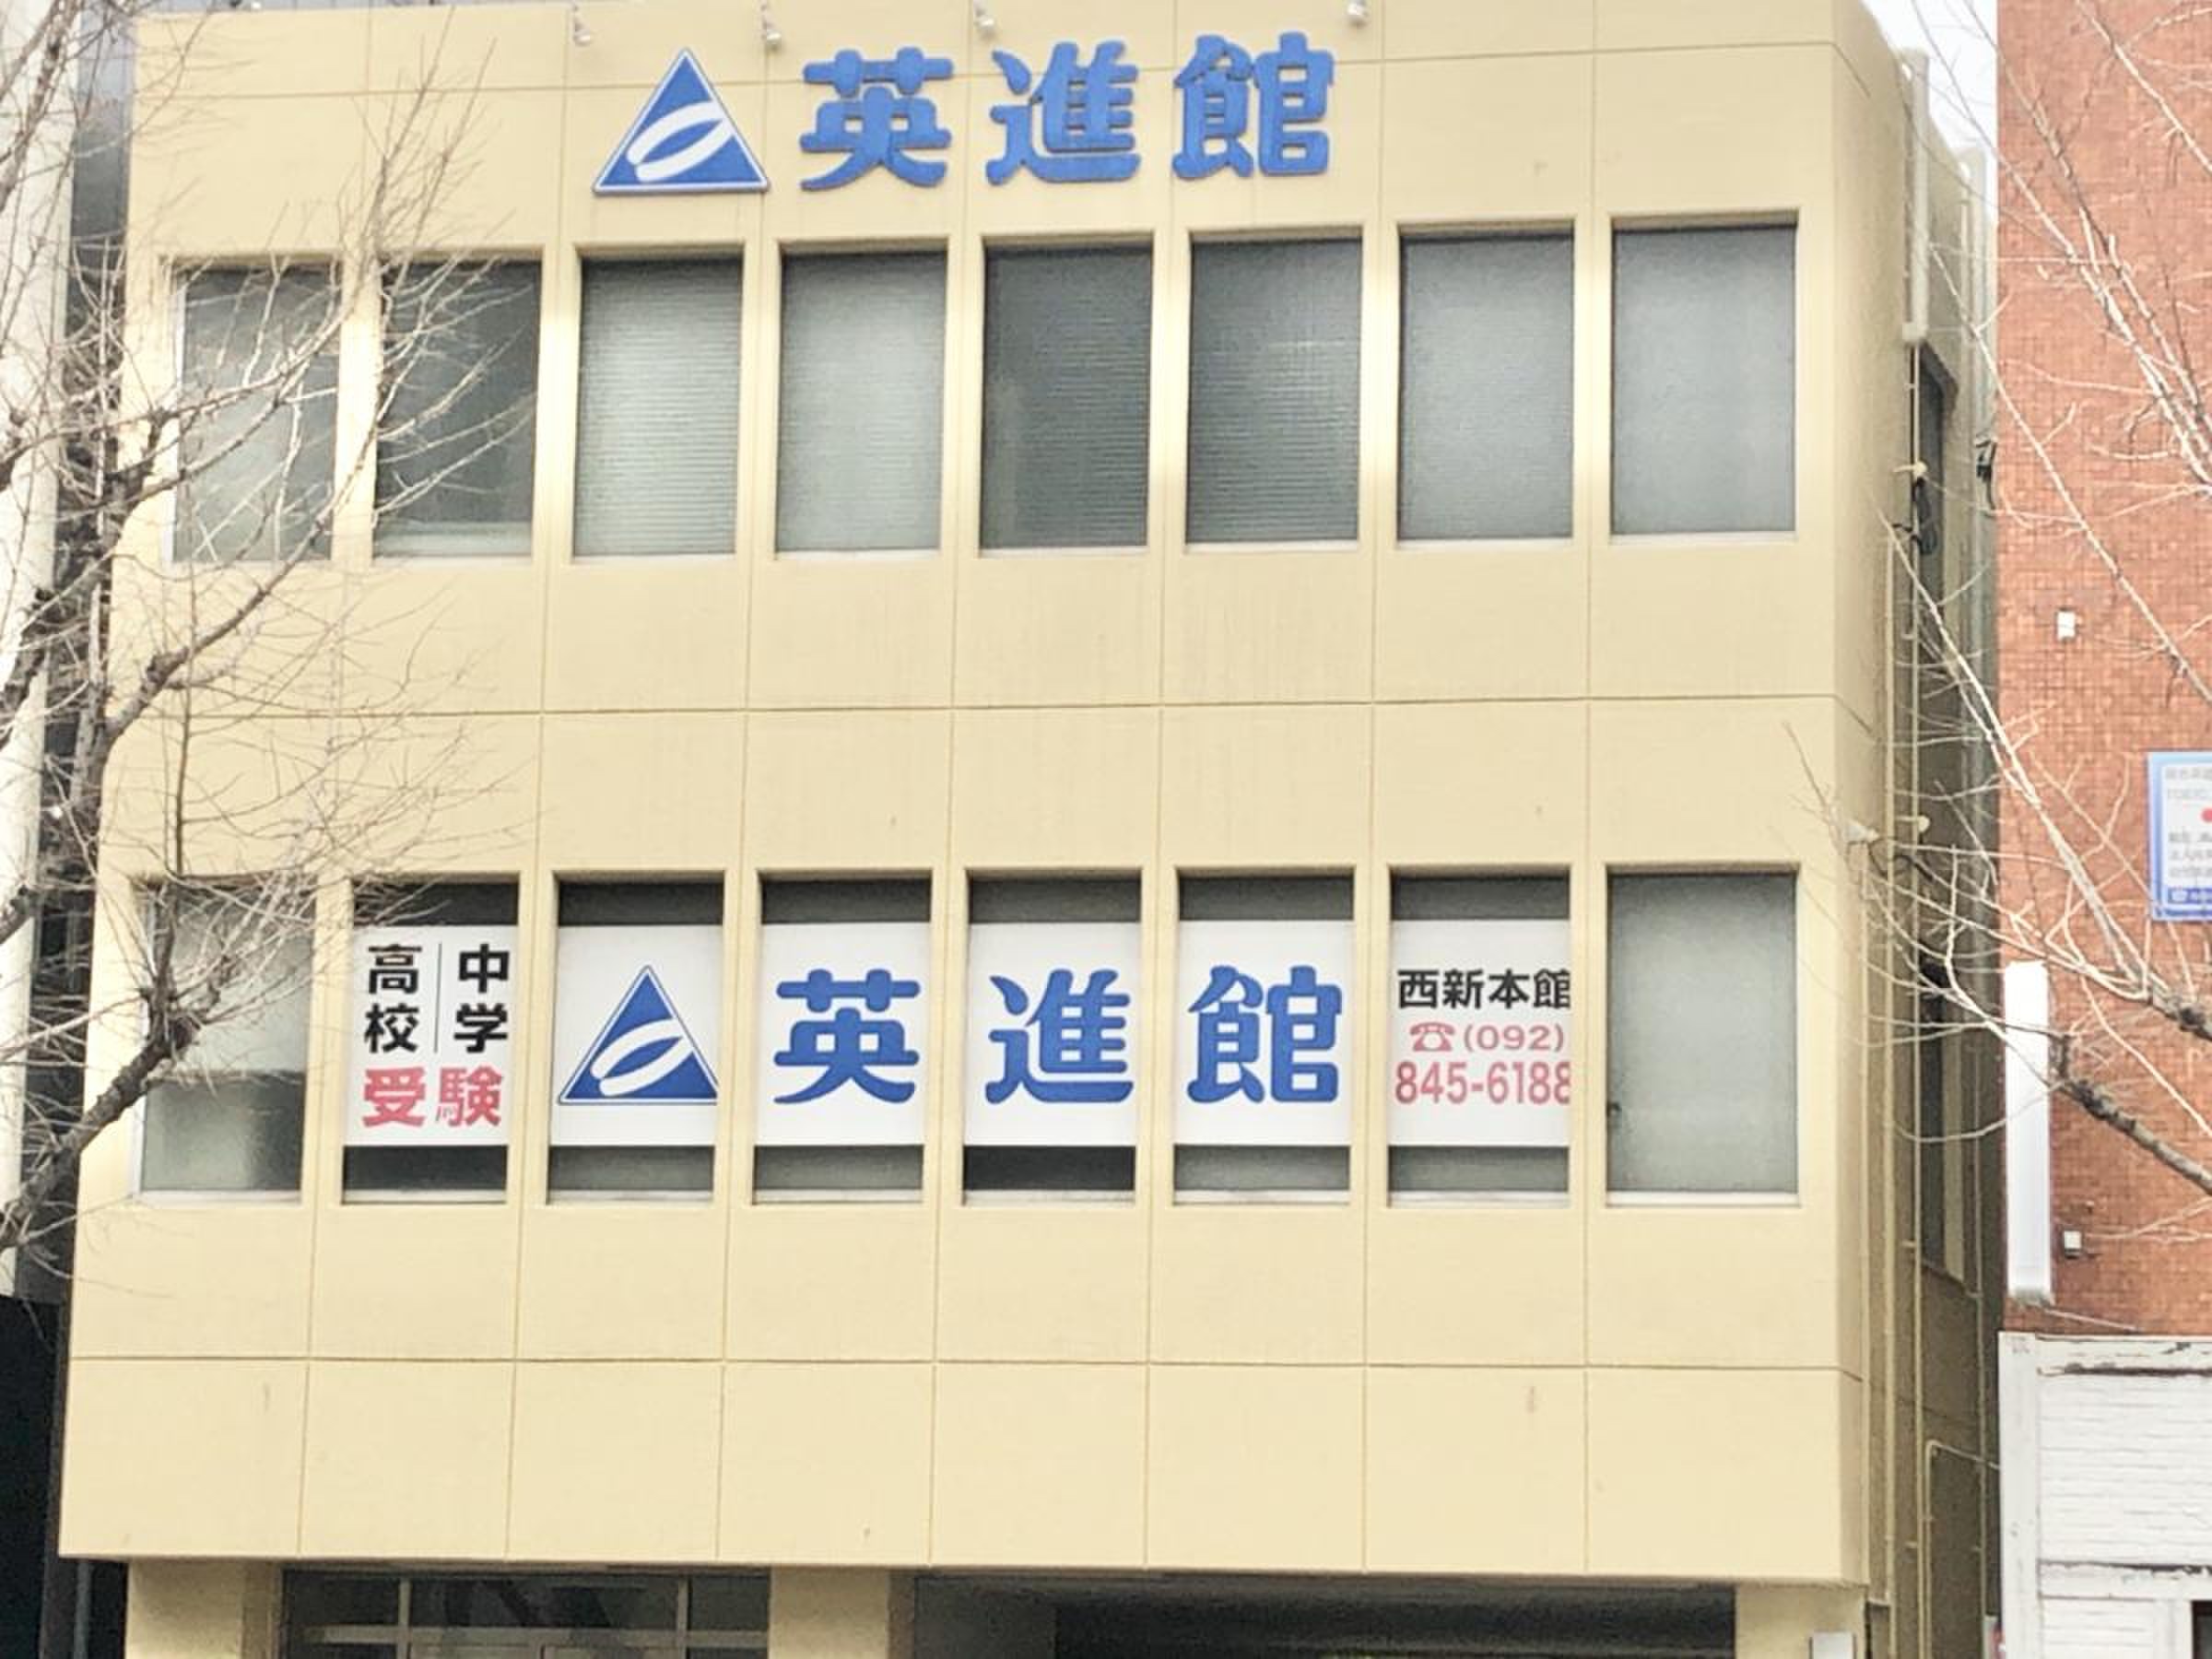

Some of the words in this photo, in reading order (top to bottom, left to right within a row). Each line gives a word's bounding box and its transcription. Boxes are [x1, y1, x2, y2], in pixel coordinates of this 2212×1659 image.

[800, 31, 1334, 191] 英進館
[364, 944, 422, 1053] 高校
[453, 944, 510, 1053] 中学
[1397, 969, 1571, 1009] 西新本館
[774, 965, 1343, 1104] 英進館
[1464, 1023, 1564, 1053] (092)
[362, 1066, 503, 1126] 受験
[1395, 1061, 1571, 1104] 845-6188
